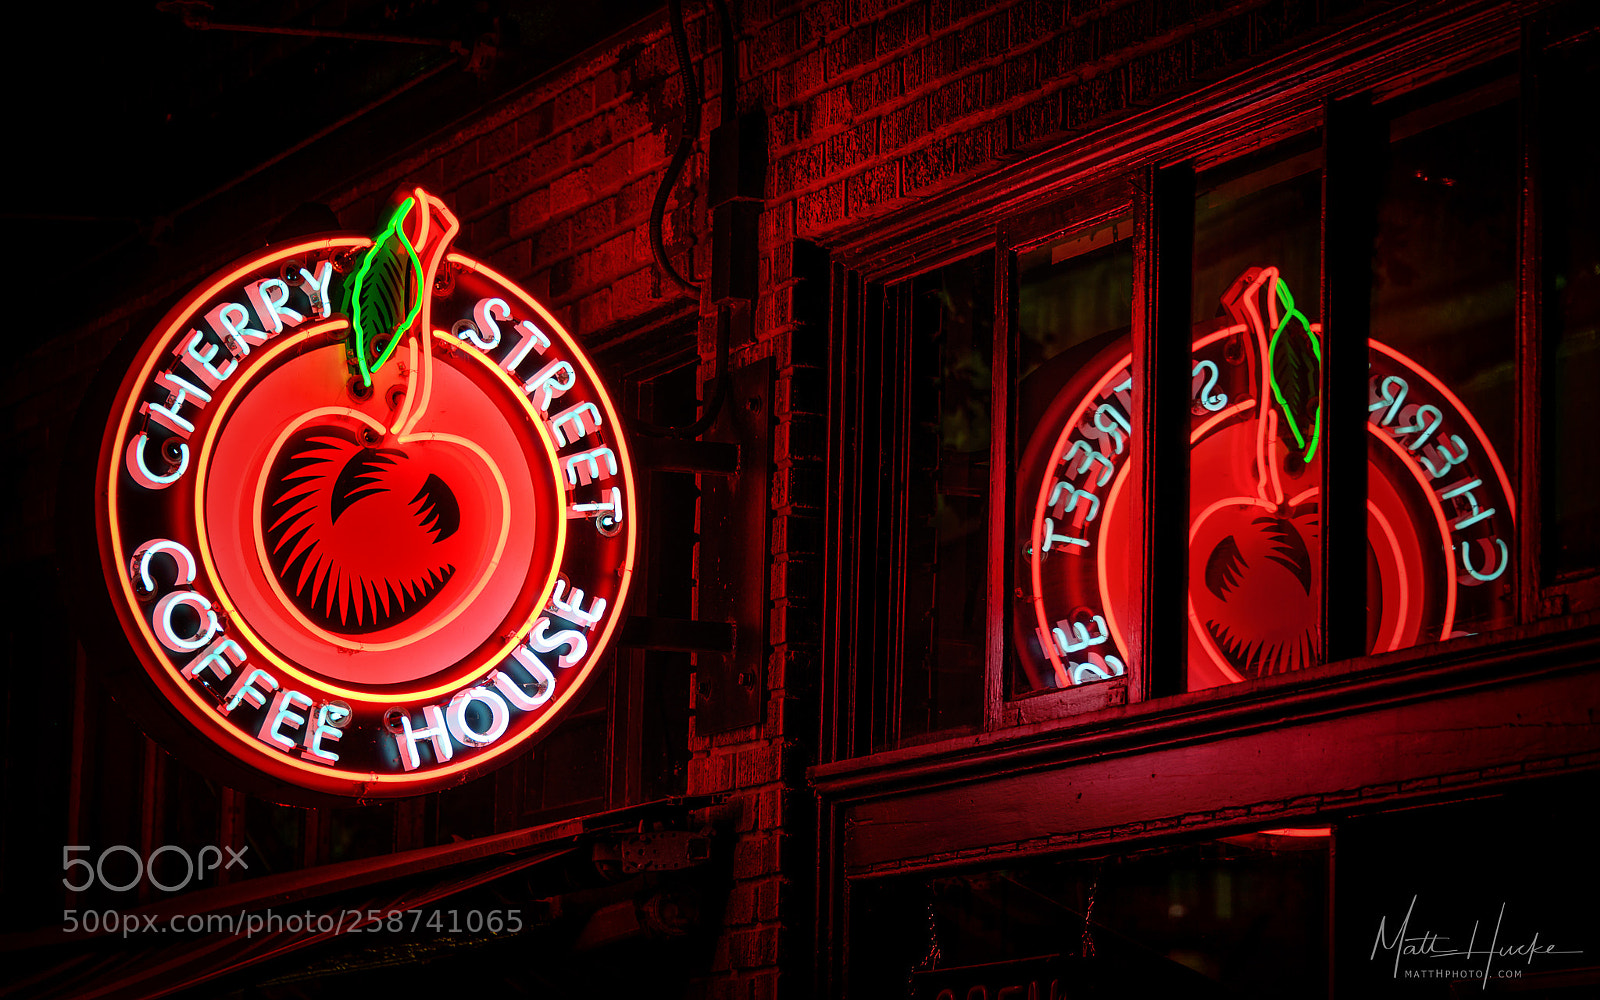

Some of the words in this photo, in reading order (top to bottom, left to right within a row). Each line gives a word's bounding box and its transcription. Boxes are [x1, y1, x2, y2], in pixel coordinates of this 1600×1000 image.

[126, 260, 333, 490] CHERRY
[455, 297, 622, 523] STREET
[130, 539, 350, 765] COFFEE
[396, 579, 607, 771] HOUSE
